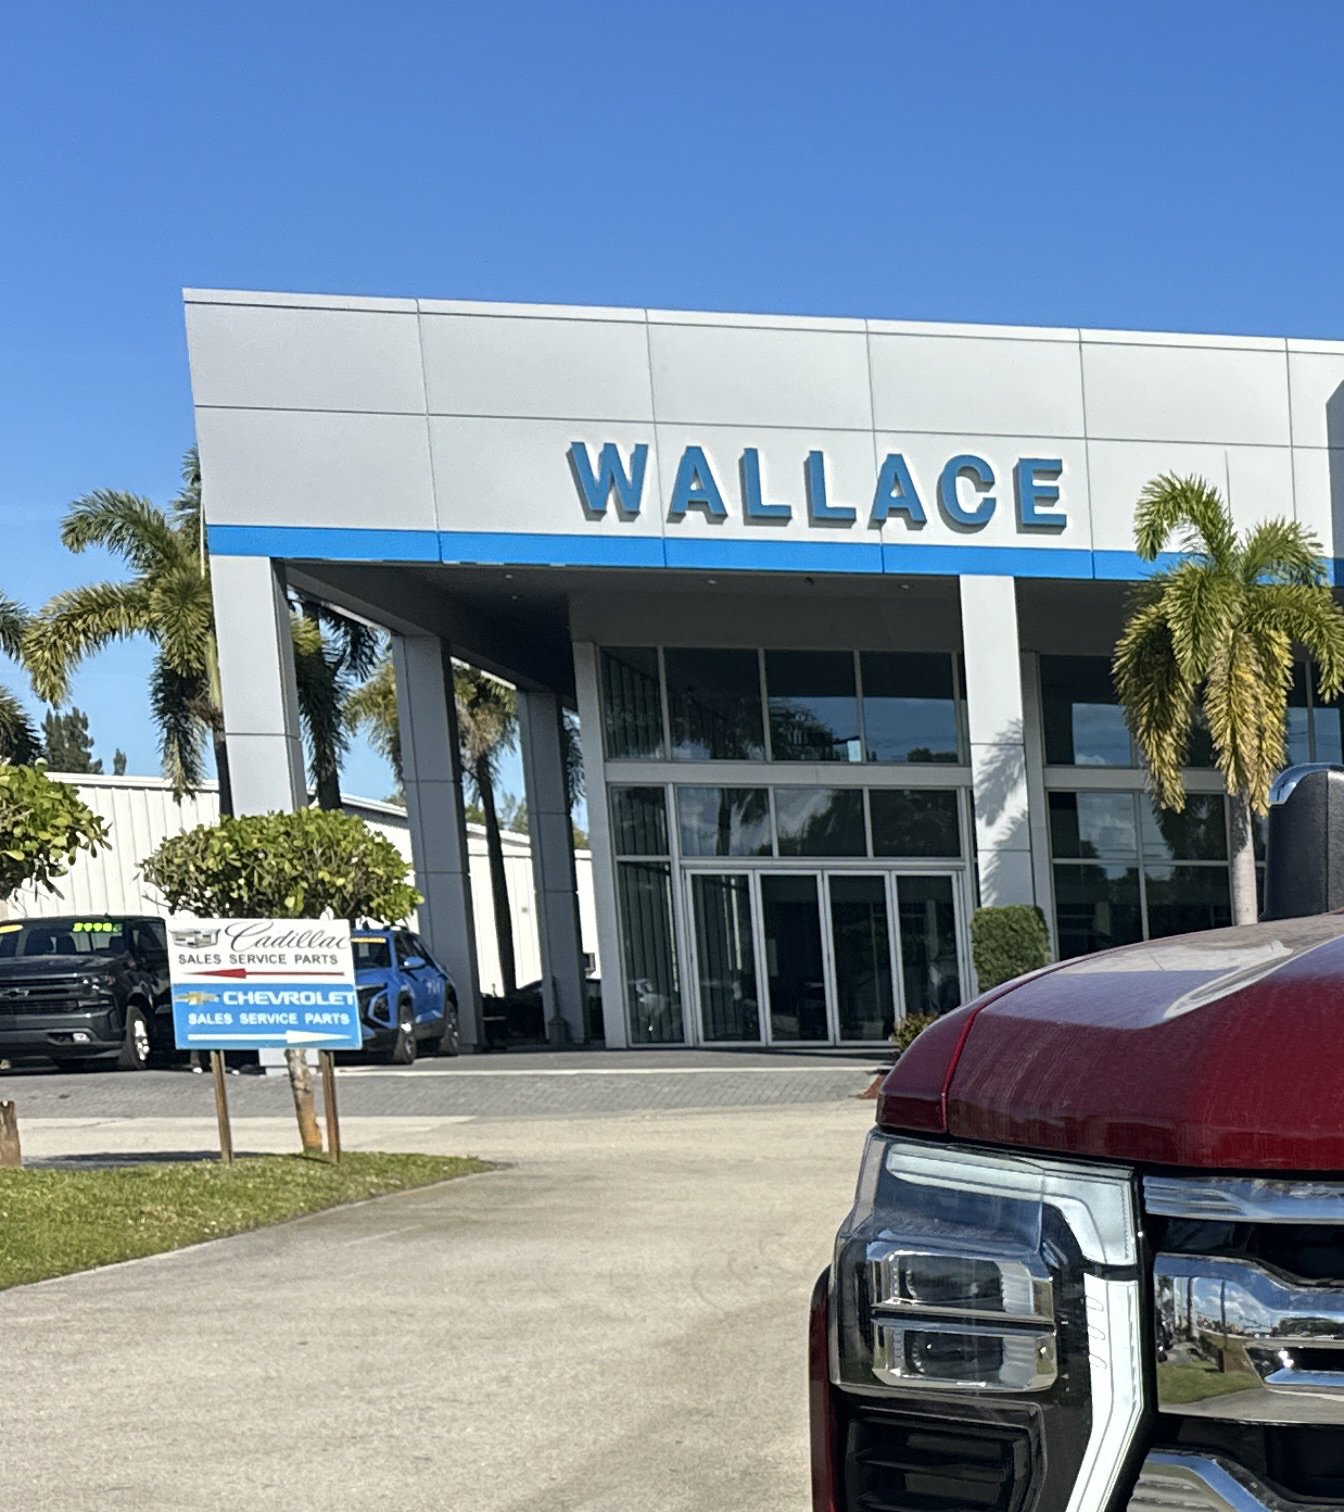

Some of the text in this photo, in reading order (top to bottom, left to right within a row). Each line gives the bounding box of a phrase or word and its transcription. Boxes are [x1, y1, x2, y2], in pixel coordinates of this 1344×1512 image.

[567, 441, 1068, 534] WALLACE
[224, 921, 350, 953] Cadillac
[178, 954, 339, 965] SALES SERVICE PARTS
[223, 991, 356, 1006] CHEVROLET
[188, 1012, 350, 1025] SALES SERVICE PARTS
